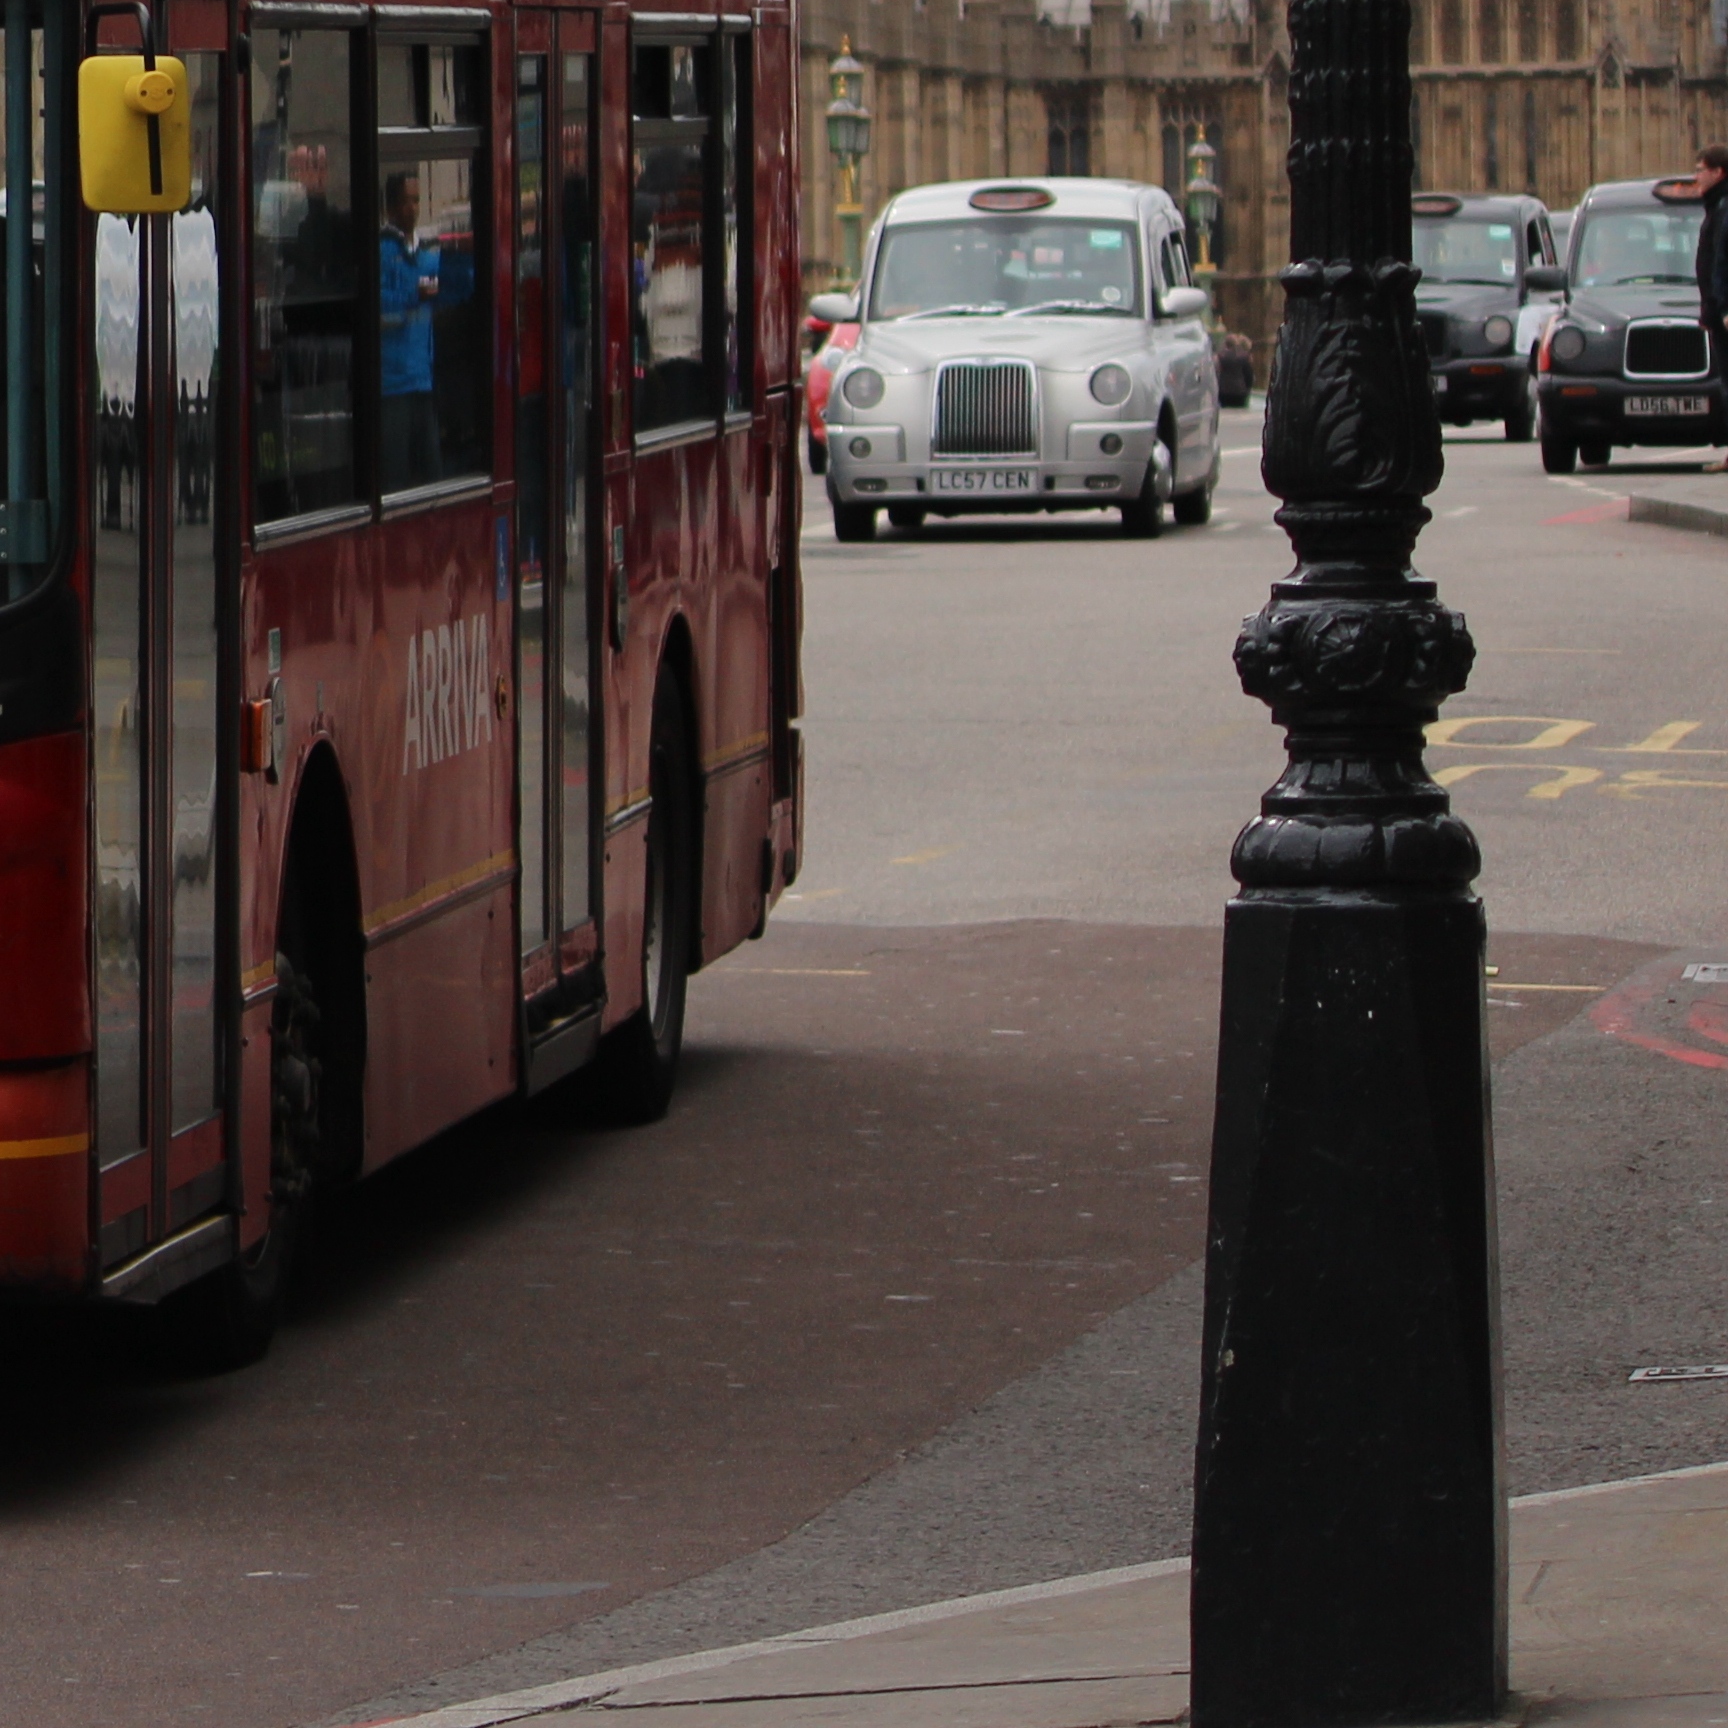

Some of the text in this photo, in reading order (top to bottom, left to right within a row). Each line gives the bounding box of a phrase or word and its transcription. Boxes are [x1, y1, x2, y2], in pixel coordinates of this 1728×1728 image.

[939, 471, 1029, 490] LC57 CEN
[402, 613, 492, 775] ARRIVA
